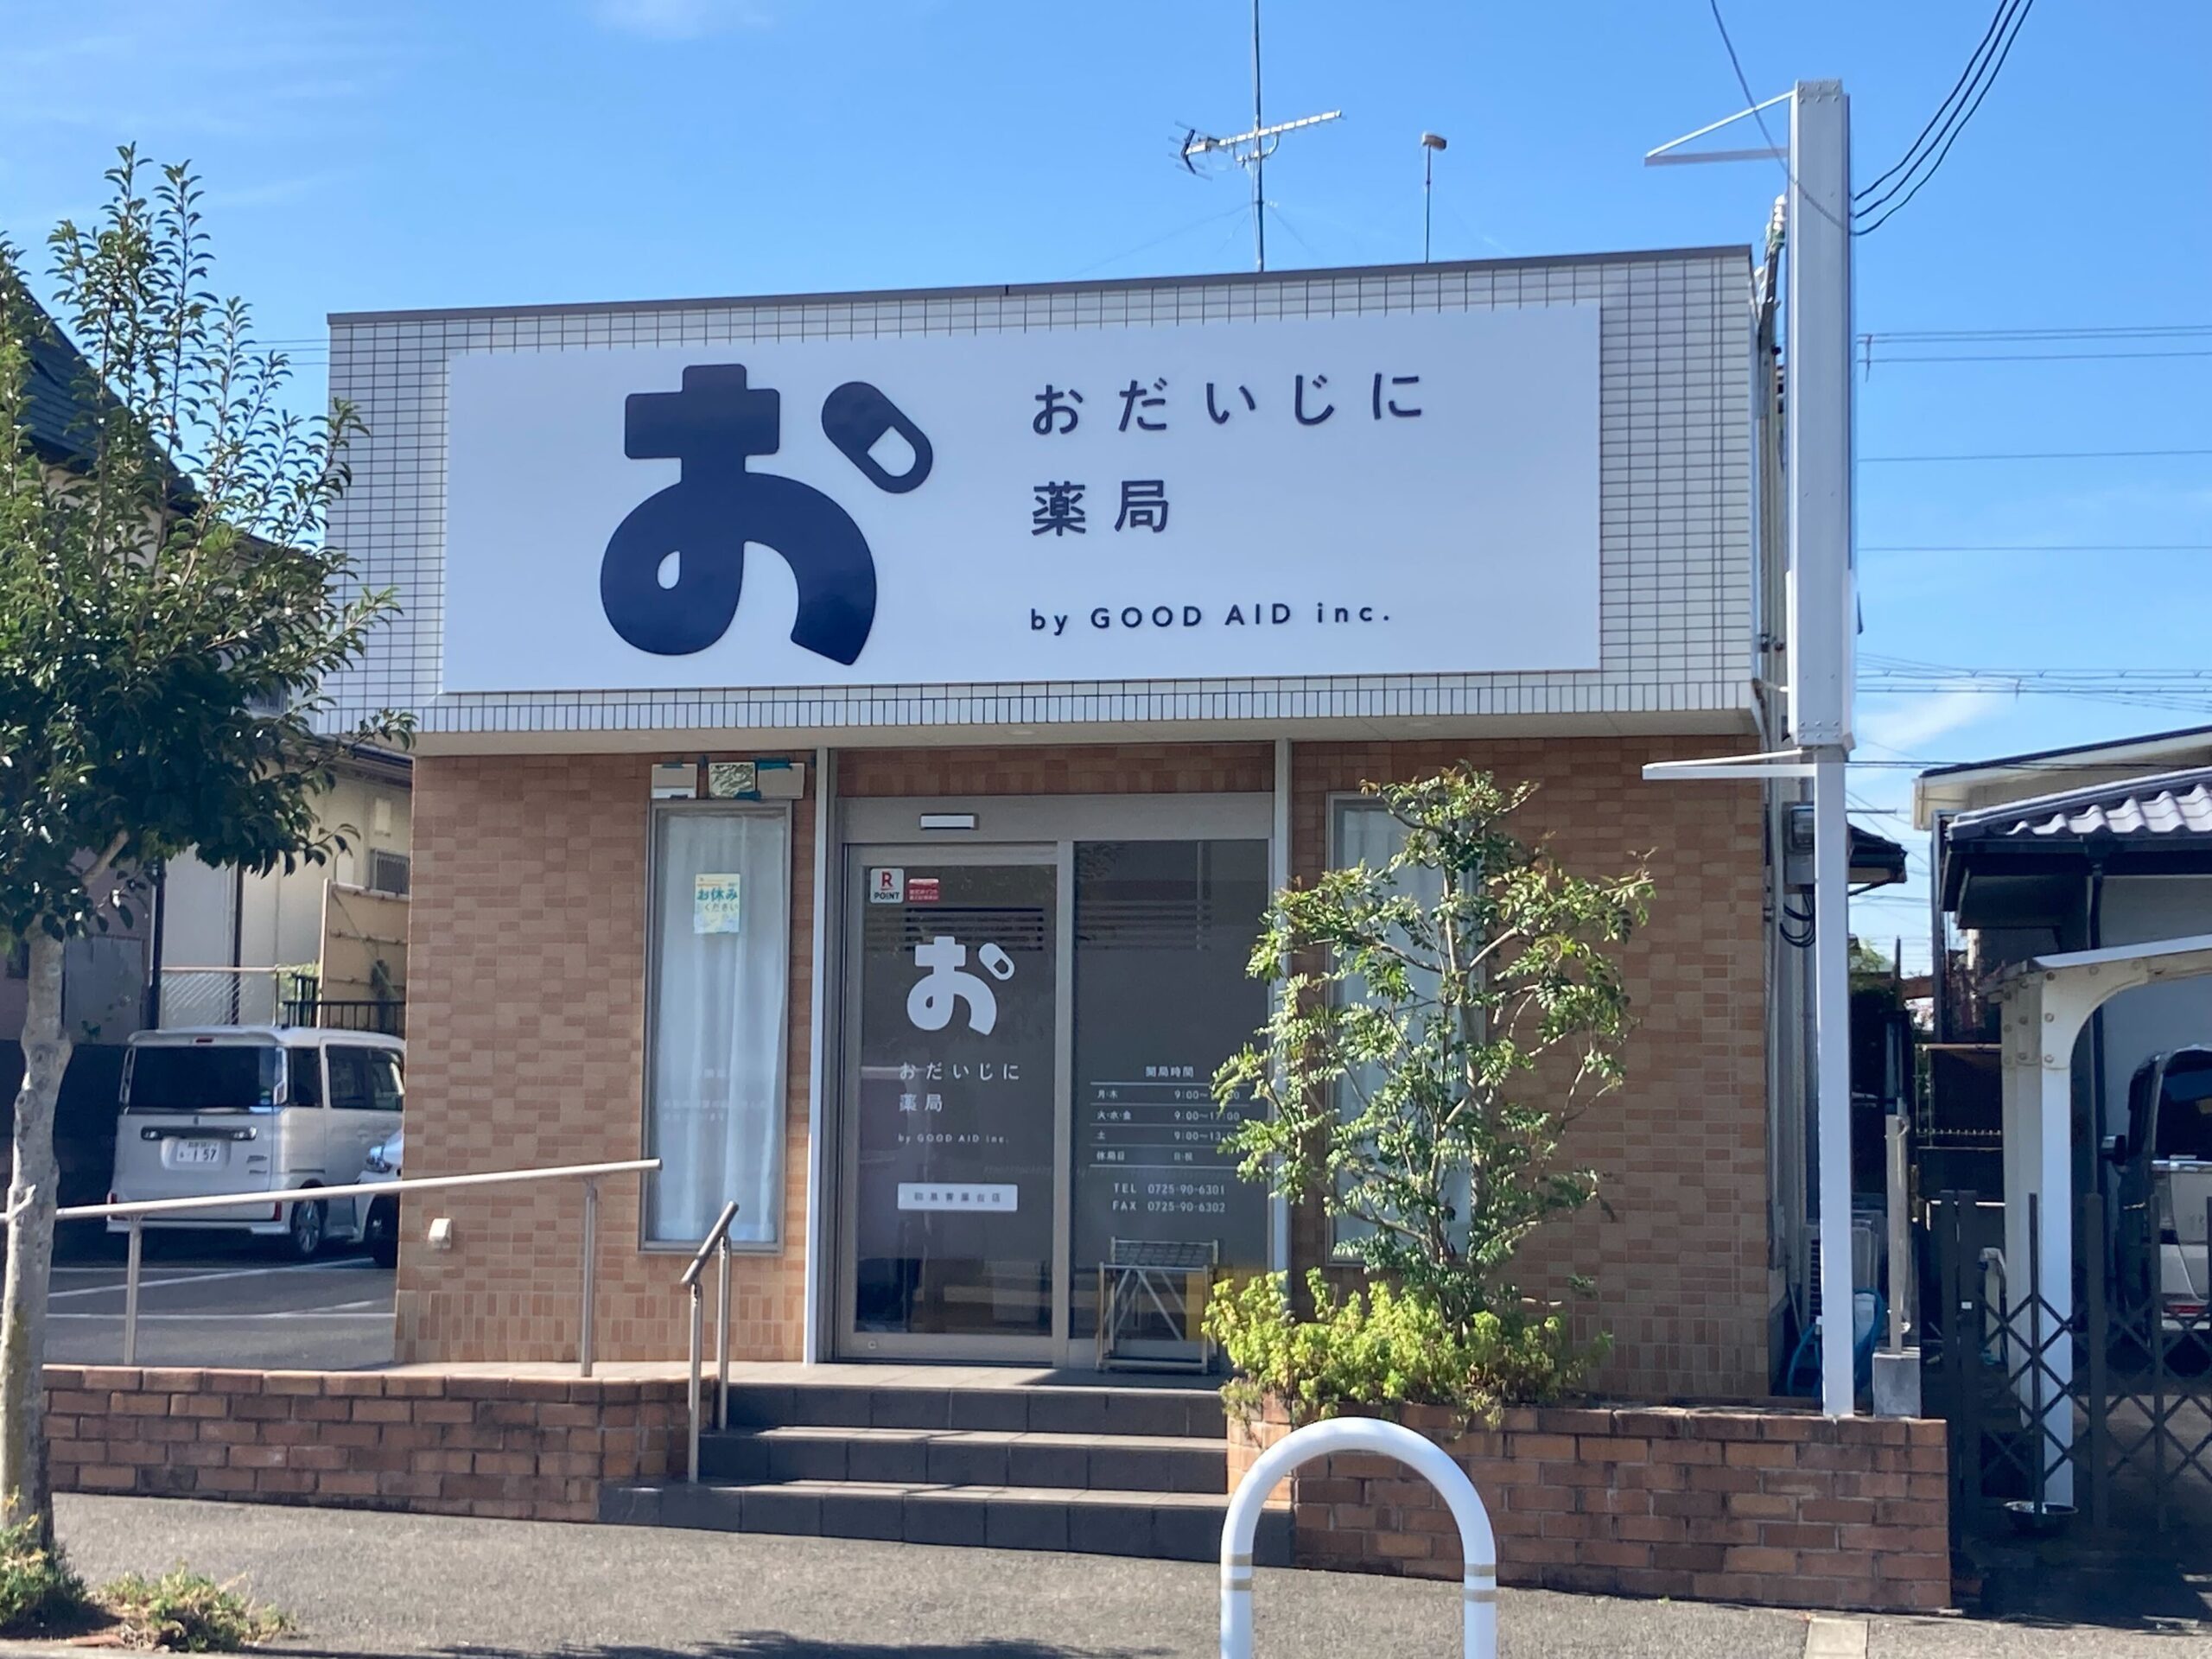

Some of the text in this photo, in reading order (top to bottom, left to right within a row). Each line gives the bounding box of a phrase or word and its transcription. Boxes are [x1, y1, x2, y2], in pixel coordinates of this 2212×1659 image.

[1033, 373, 1421, 435] おだいじに
[601, 364, 933, 665] お
[1032, 480, 1168, 537] 薬局
[1032, 602, 1389, 636] by GOOD AID inc.
[881, 871, 893, 887] R
[899, 1061, 1020, 1081] おだいじに
[899, 1093, 943, 1112] 薬局
[899, 1134, 911, 1144] by
[917, 1134, 953, 1143] GOOD
[958, 1134, 980, 1142] AID
[1114, 1183, 1136, 1193] TEL
[1112, 1200, 1137, 1211] FAX
